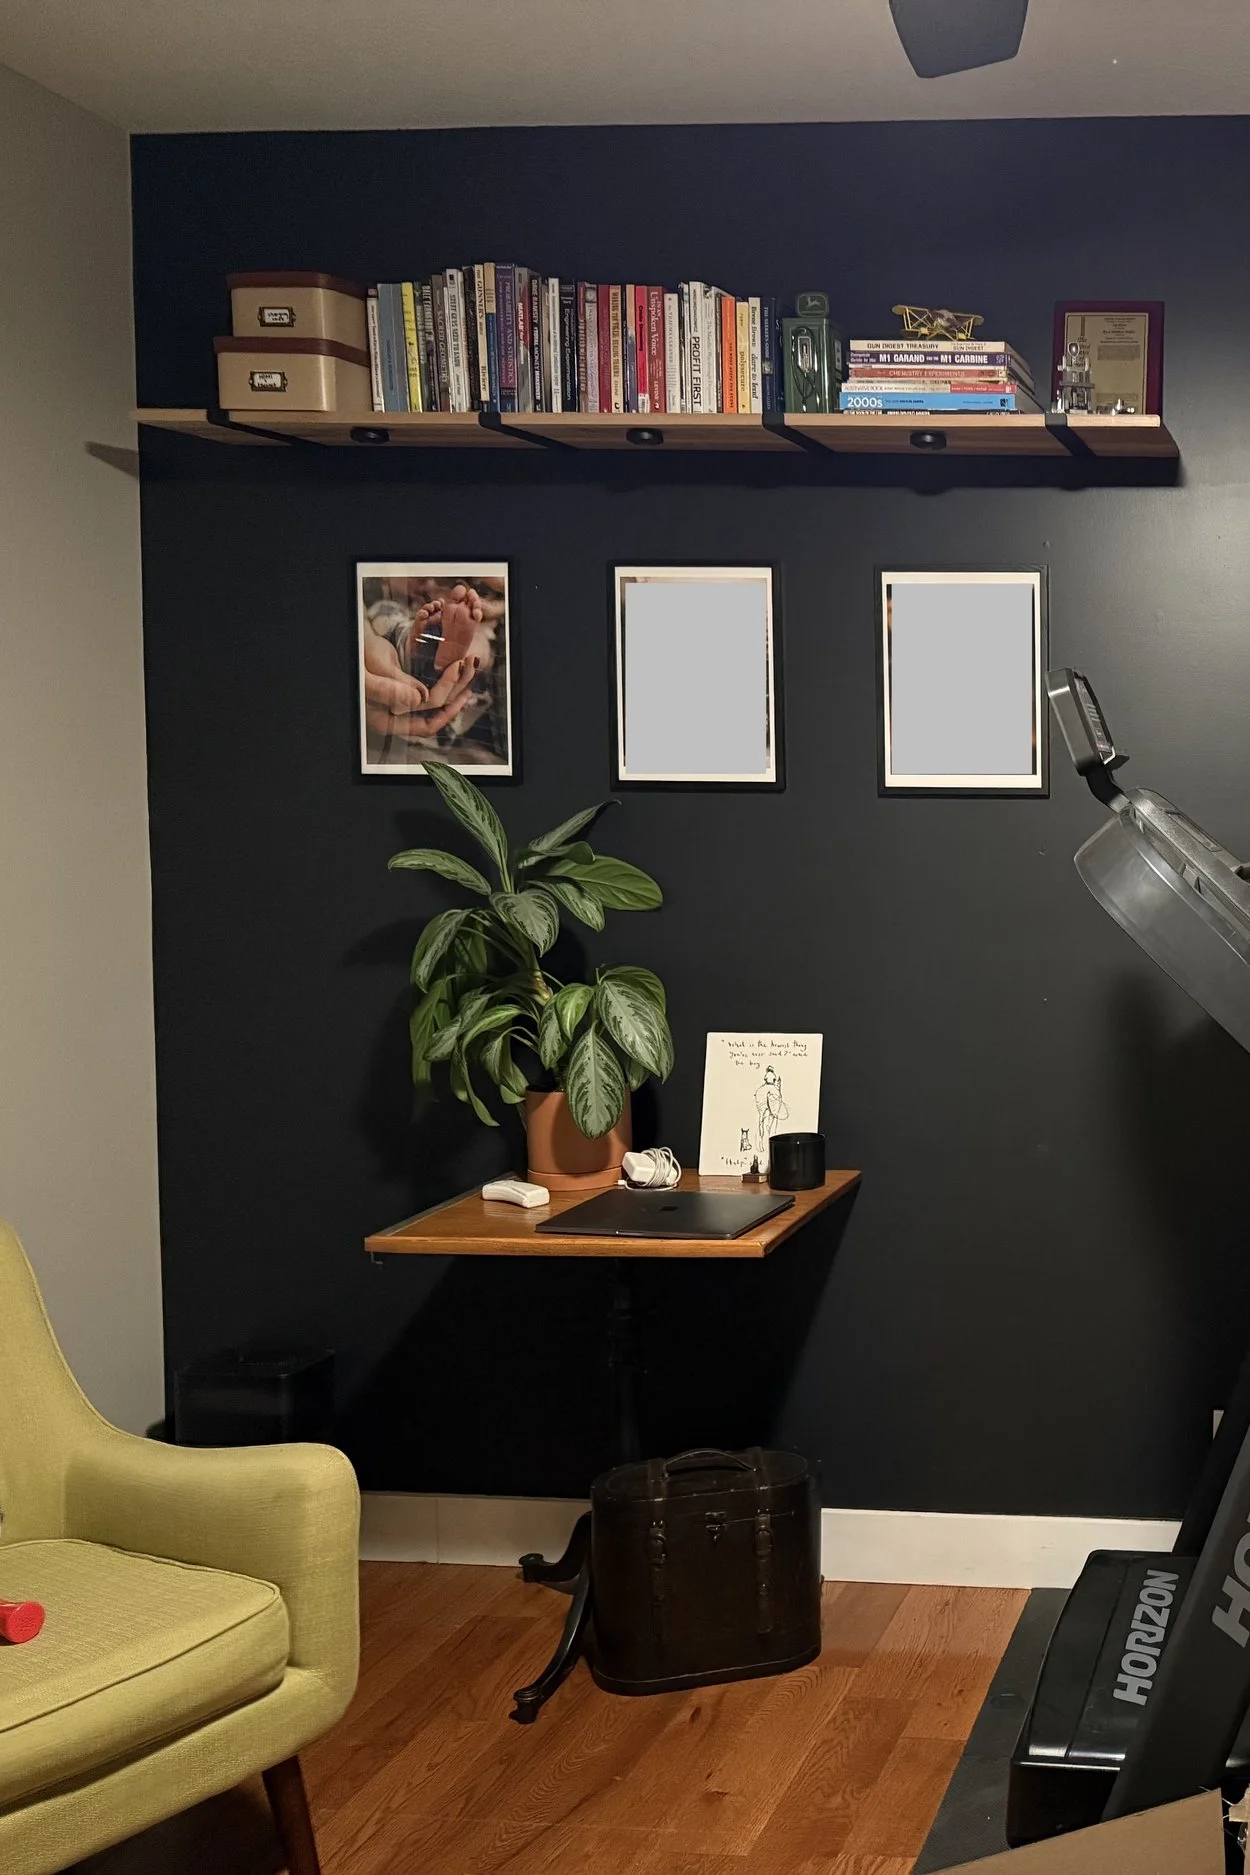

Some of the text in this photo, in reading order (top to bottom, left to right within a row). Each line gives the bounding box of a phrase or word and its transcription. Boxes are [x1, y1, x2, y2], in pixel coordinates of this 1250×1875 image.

[649, 292, 658, 332] Unspoken
[434, 310, 448, 383] SACRED GEOMETRY
[651, 333, 659, 355] Voice
[879, 354, 988, 364] M1 GARAND M1 CARBINE
[692, 336, 702, 406] PROFIT FIRST
[847, 397, 882, 407] 2000s
[758, 1040, 767, 1048] the
[793, 1041, 807, 1051] thing
[750, 1060, 760, 1069] boy
[1113, 1569, 1179, 1706] HORIZON
